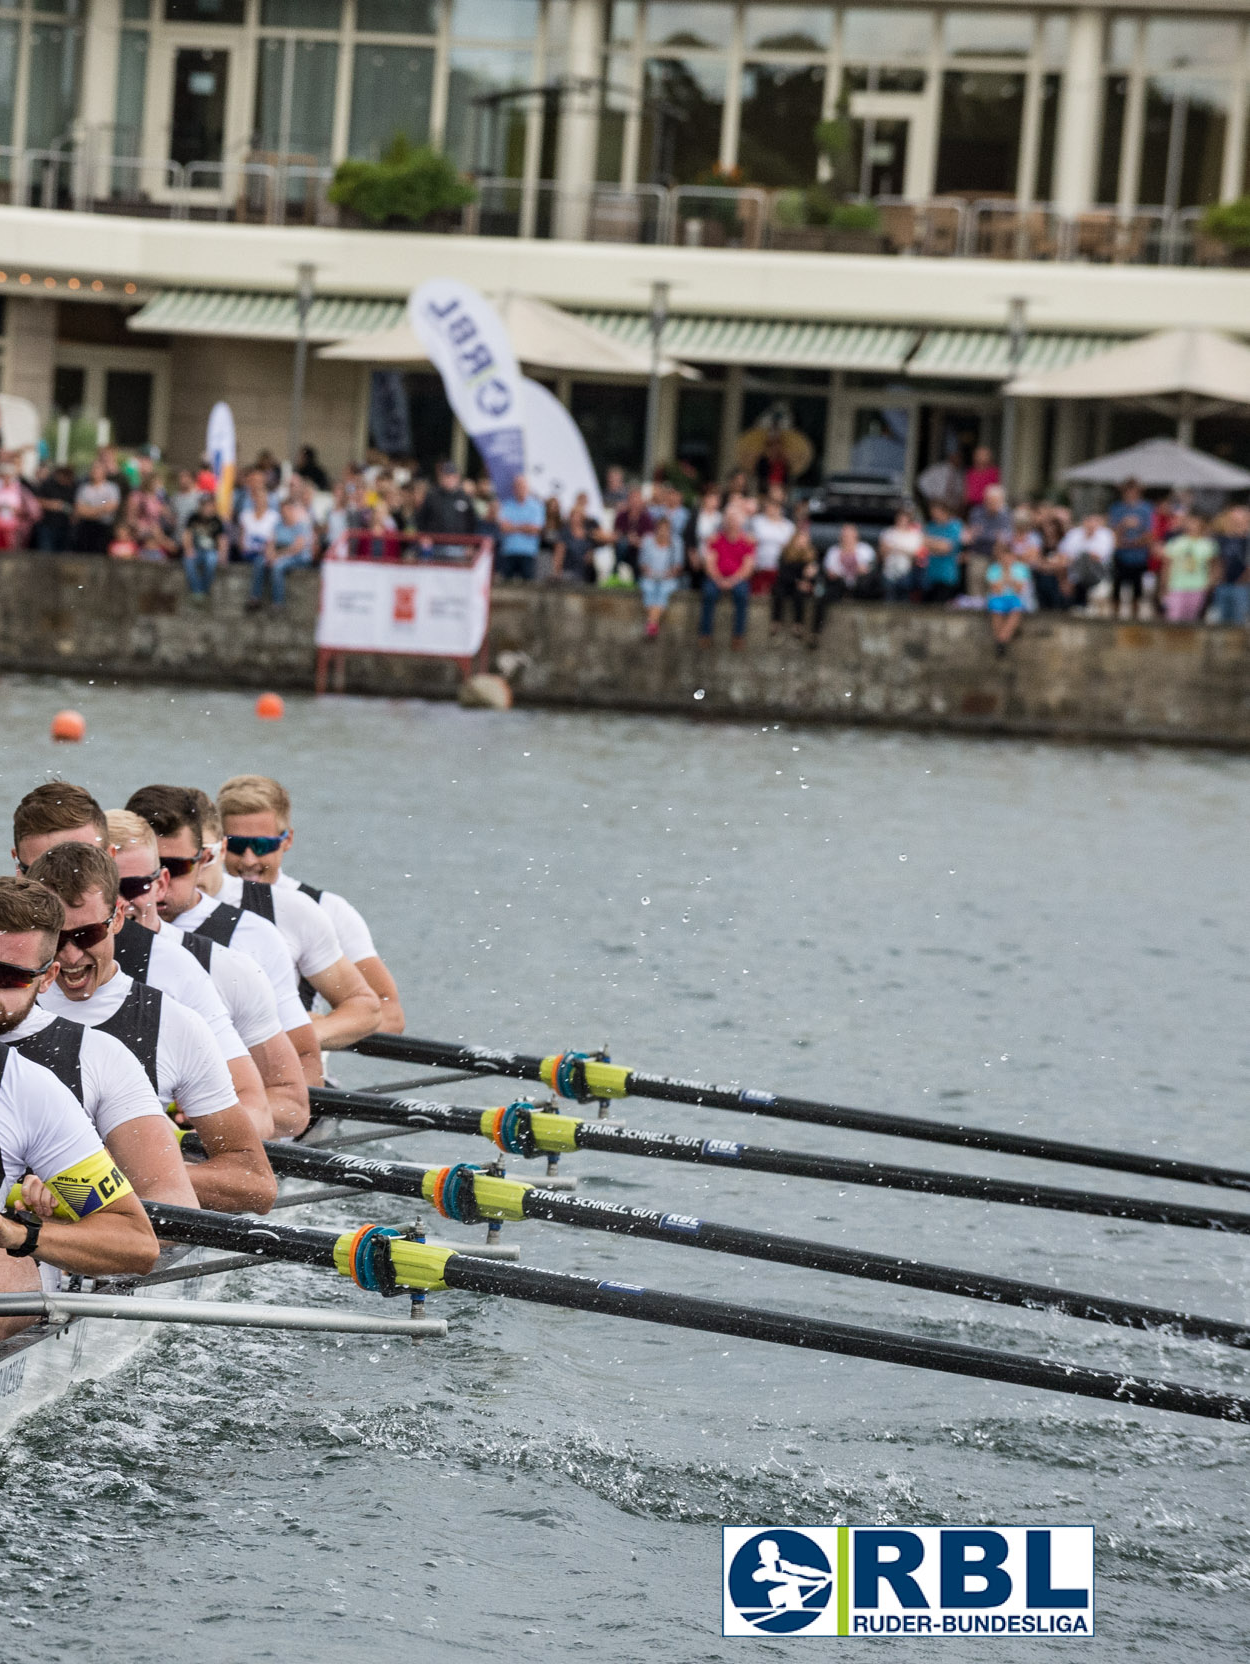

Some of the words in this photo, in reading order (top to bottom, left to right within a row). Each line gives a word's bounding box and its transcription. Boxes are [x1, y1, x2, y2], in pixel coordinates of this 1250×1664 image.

[581, 1122, 619, 1137] STARK.
[620, 1127, 672, 1144] SCHNELL.
[675, 1137, 701, 1148] GUT.
[708, 1139, 739, 1151] RBL
[530, 1188, 571, 1204] STARK.
[573, 1196, 629, 1215] SCHNELL.
[631, 1207, 658, 1220] GUT.
